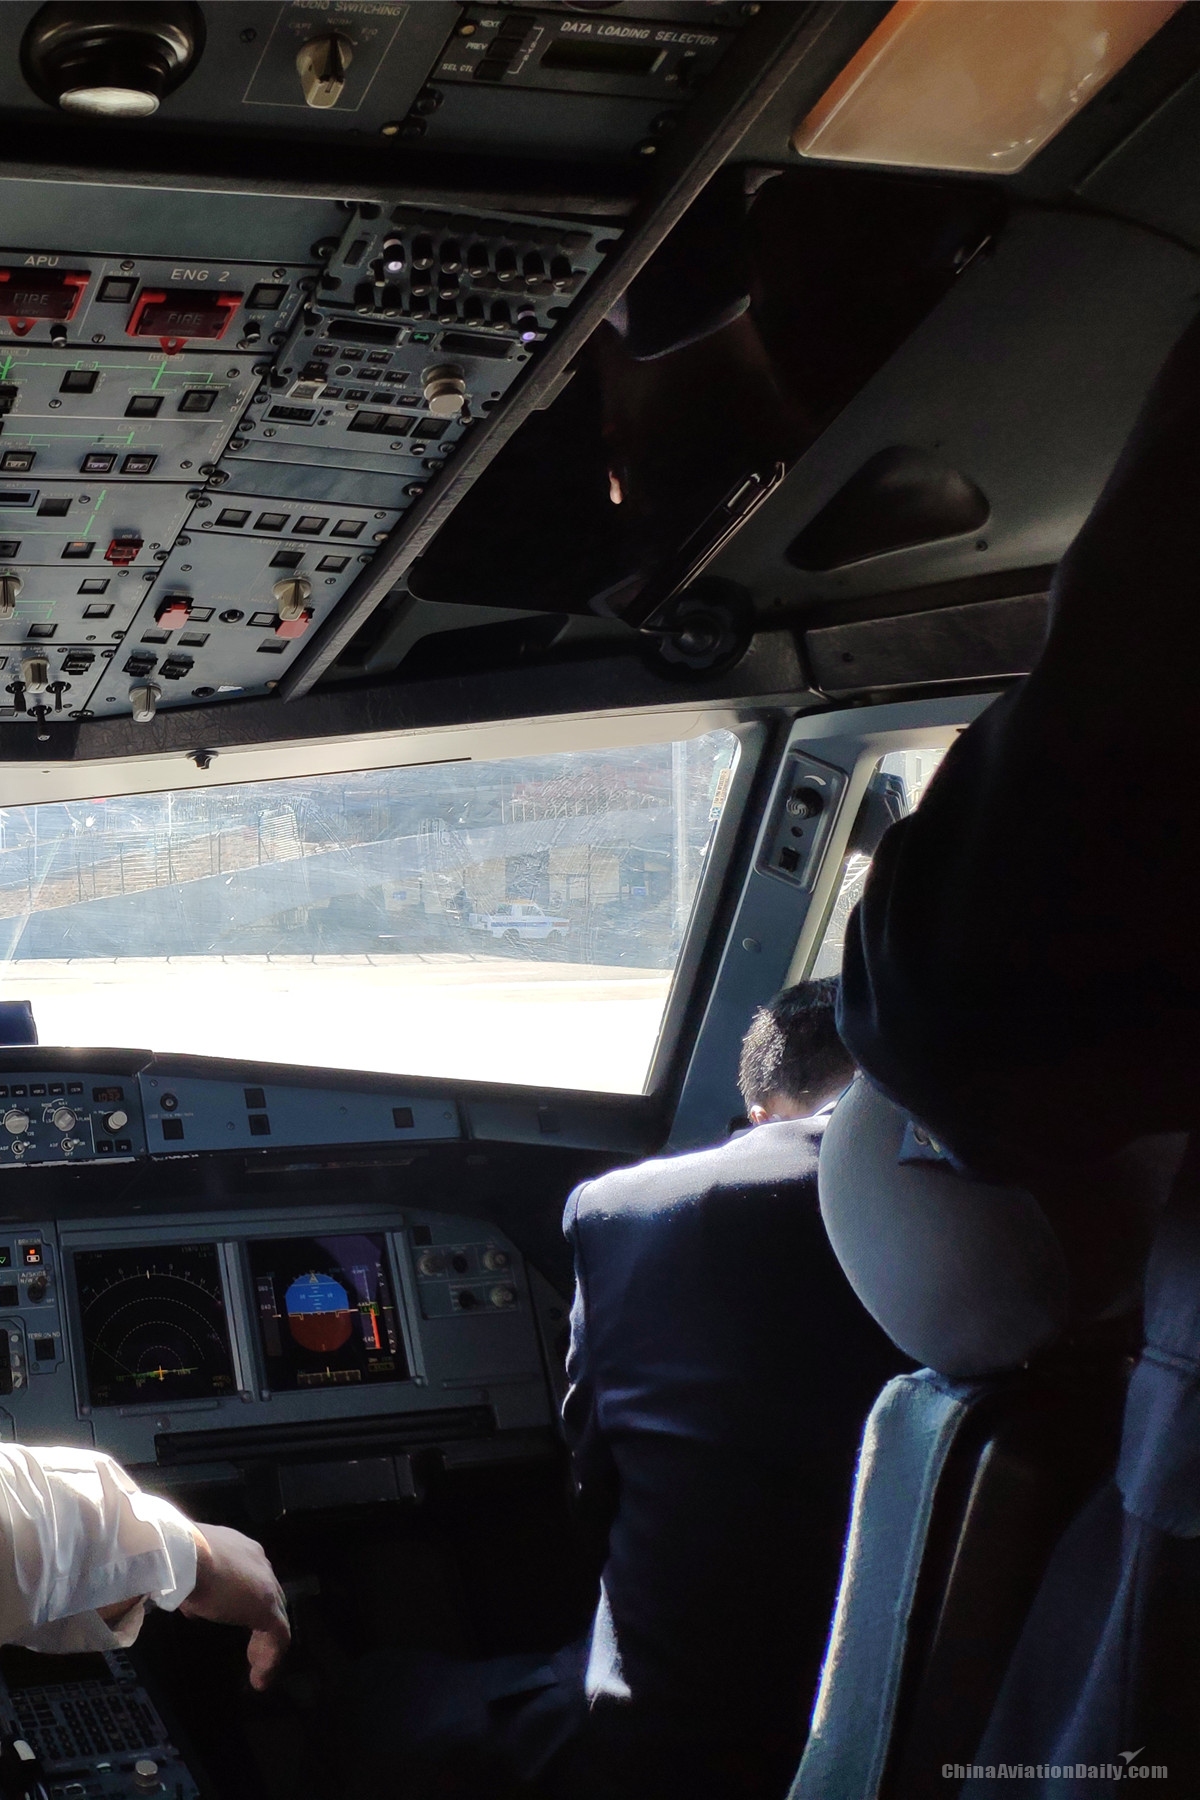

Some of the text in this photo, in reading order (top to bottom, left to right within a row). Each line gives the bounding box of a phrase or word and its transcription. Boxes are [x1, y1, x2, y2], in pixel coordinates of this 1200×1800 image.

[335, 2, 402, 16] SWITCHING
[480, 20, 501, 28] NEXT
[560, 21, 720, 46] DATA LOADING SELECTOR
[465, 42, 487, 51] PREV
[442, 63, 458, 72] SEL
[24, 256, 59, 267] APU
[170, 268, 231, 283] ENG 2
[13, 292, 49, 305] FIRE
[167, 311, 202, 325] FIRE
